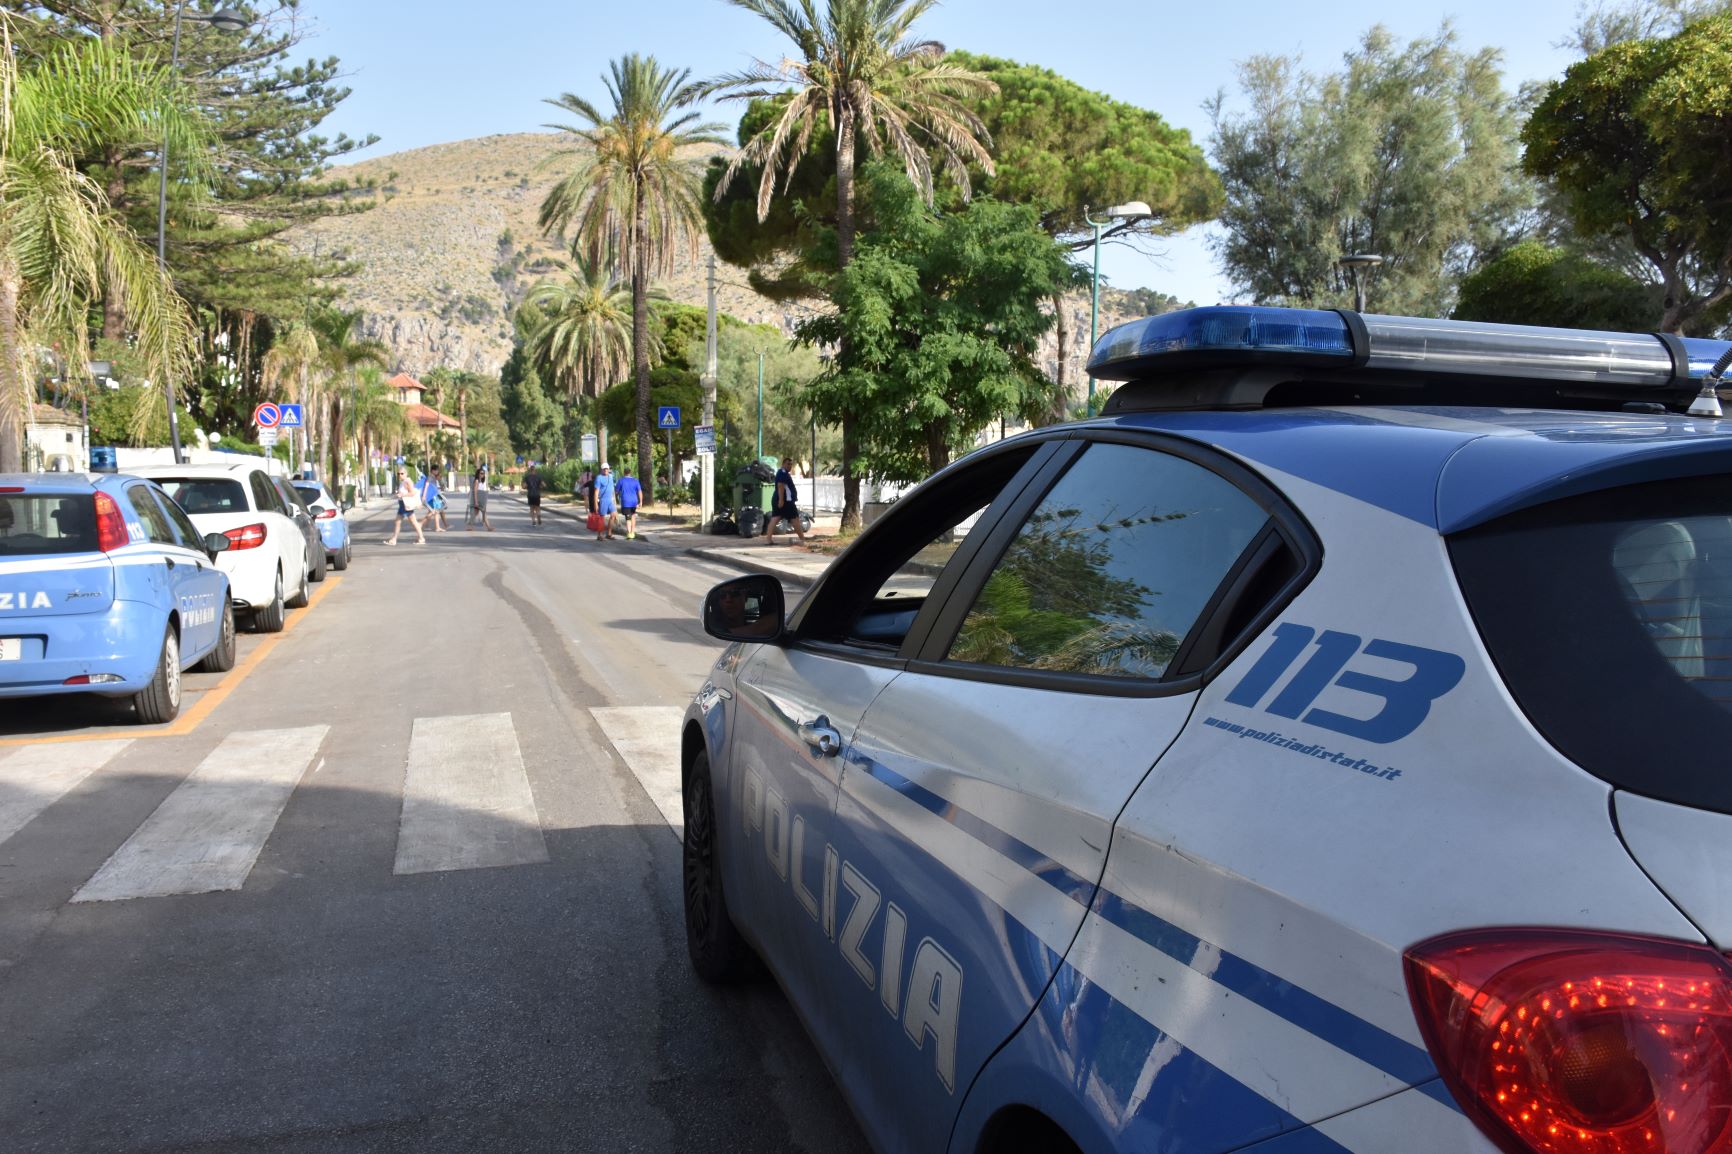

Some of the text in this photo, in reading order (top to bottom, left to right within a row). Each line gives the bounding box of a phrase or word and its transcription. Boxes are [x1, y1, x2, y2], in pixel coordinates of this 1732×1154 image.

[127, 522, 145, 540] 113
[1224, 622, 1466, 744] 113
[1202, 716, 1402, 781] www.poliziadistato.it
[742, 764, 964, 1095] POLIZIA
